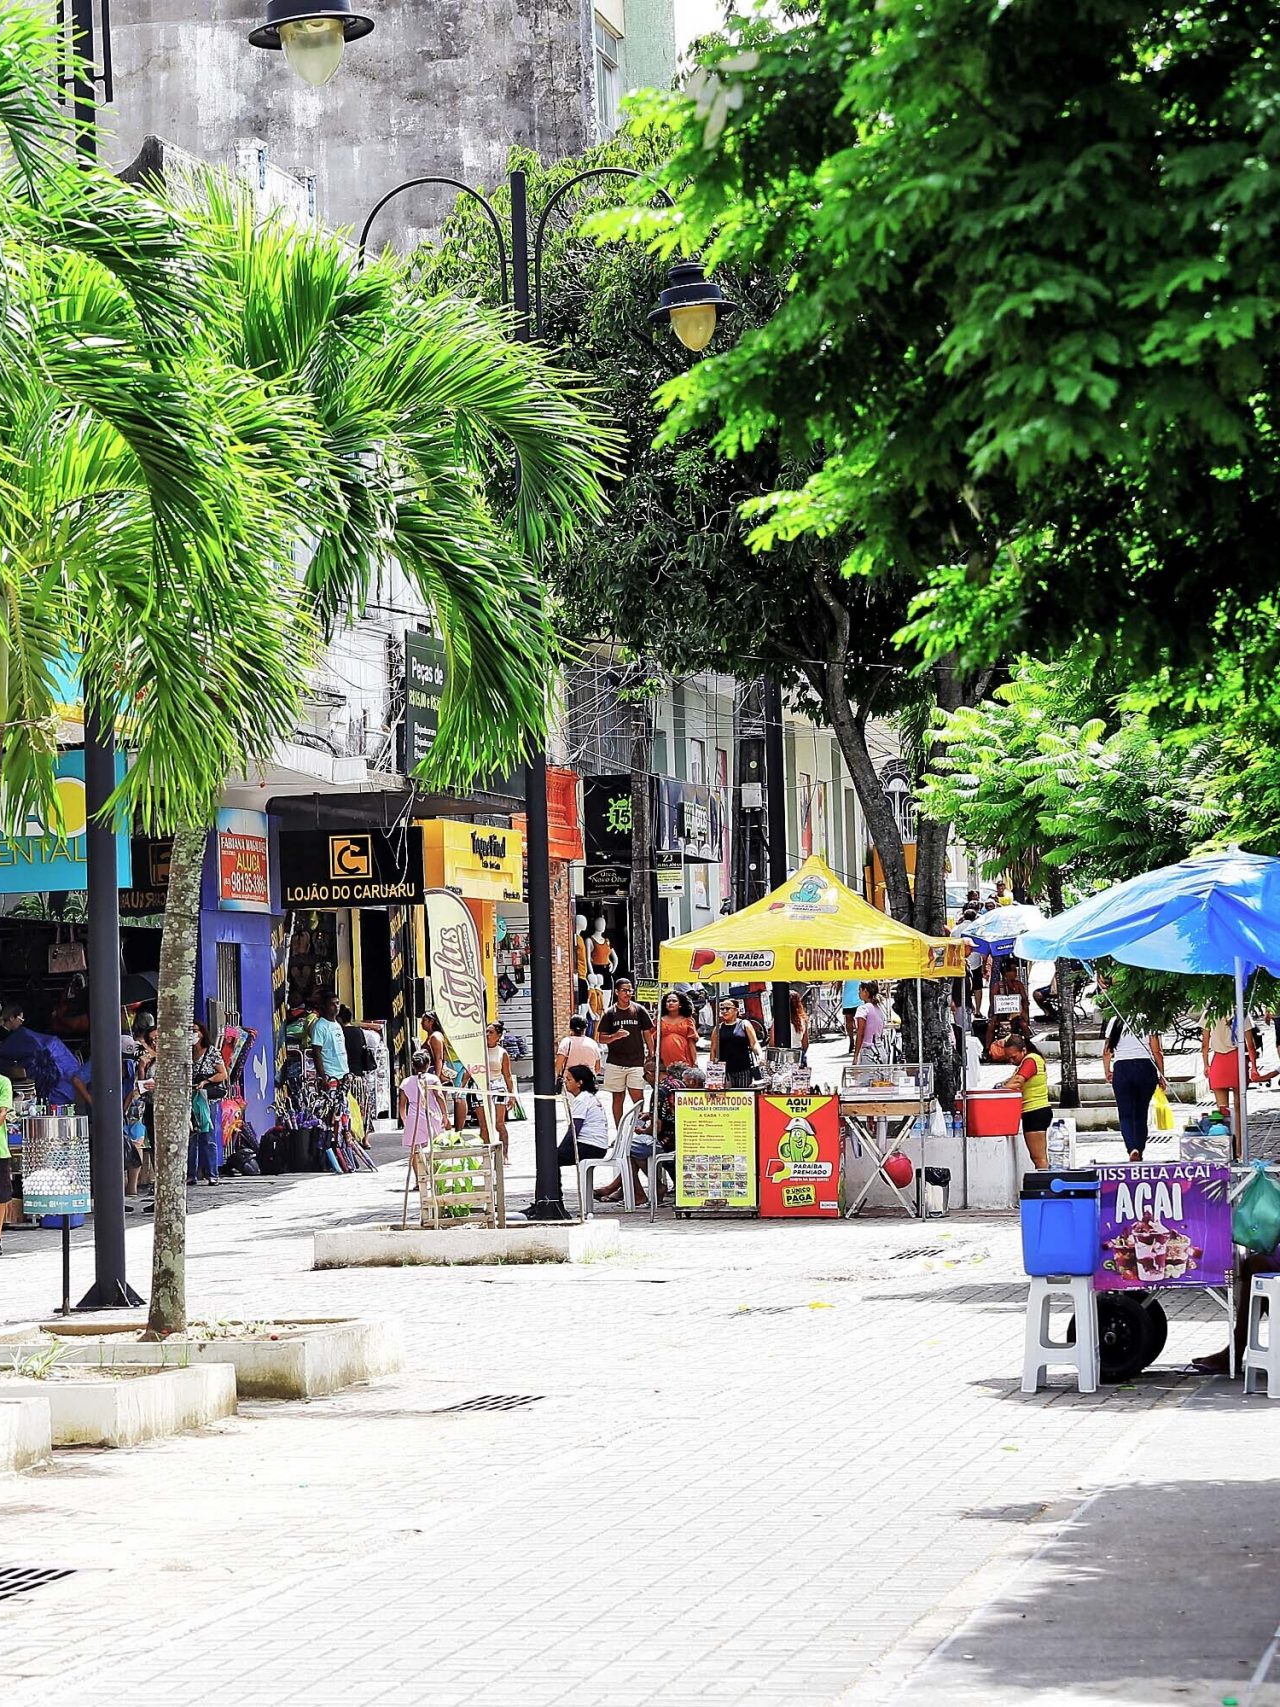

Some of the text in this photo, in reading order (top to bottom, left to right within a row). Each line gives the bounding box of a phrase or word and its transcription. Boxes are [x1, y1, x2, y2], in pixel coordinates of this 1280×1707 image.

[411, 656, 444, 686] Peças de
[613, 808, 631, 825] 15
[236, 852, 261, 872] ALUGA
[286, 883, 329, 901] LOJÃO
[332, 884, 350, 900] DO
[353, 882, 416, 900] CARUARU
[727, 952, 765, 960] PARAÍBA
[794, 947, 885, 972] COMPRE AQUI
[726, 960, 772, 968] PREMIADO
[677, 1096, 753, 1106] BANCA PARATODOS
[786, 1098, 812, 1106] AQUI
[1130, 1166, 1170, 1180] BELA
[786, 1193, 813, 1203] PAGA
